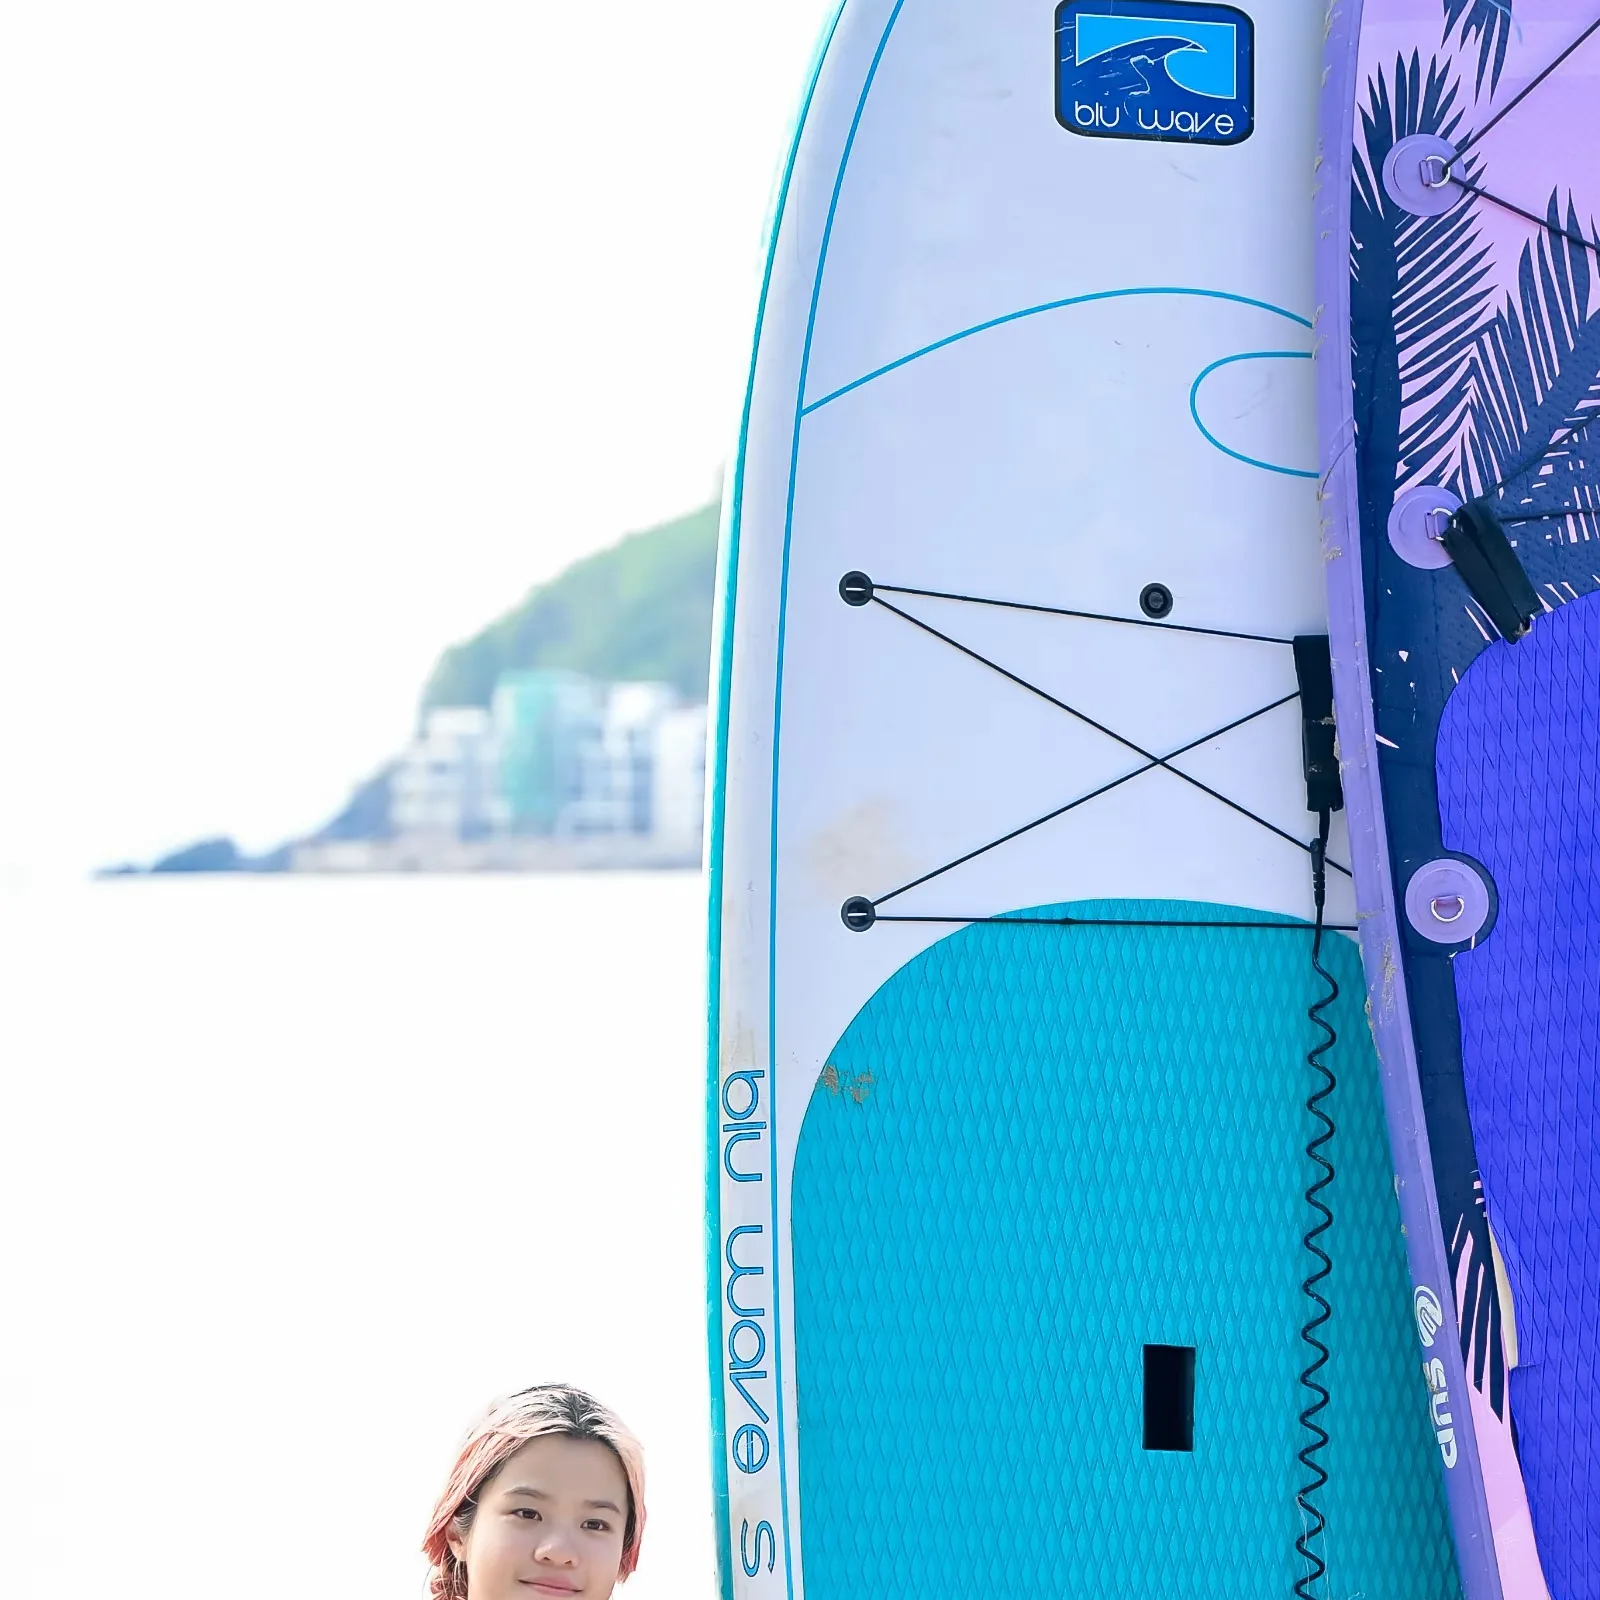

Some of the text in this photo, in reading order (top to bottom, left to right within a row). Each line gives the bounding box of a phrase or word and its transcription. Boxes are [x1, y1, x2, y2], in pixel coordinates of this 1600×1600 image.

[1074, 100, 1235, 136] blu wave
[722, 1068, 767, 1183] blu
[725, 1224, 771, 1475] wave
[1422, 1357, 1458, 1469] SUP
